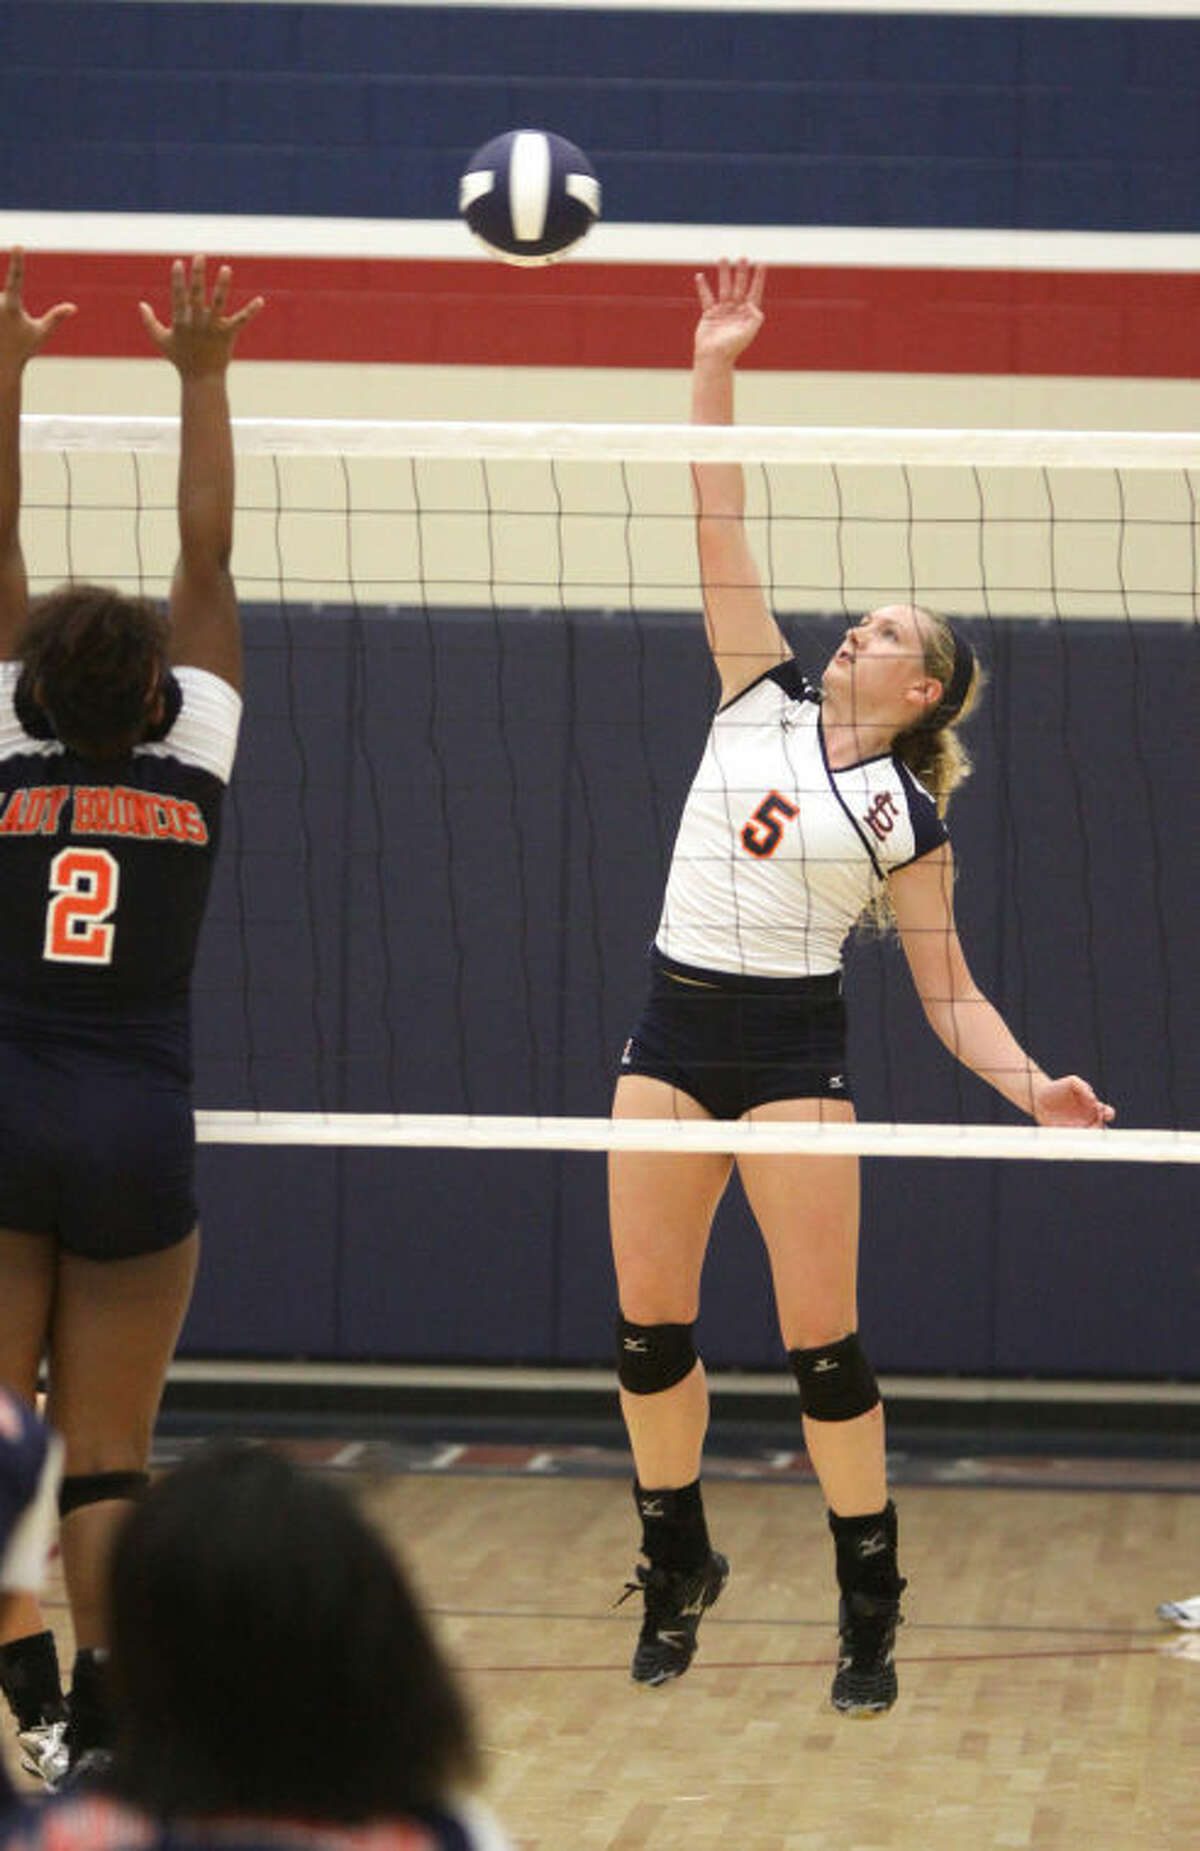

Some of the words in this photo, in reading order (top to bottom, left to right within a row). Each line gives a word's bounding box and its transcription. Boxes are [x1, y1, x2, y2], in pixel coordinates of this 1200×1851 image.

[0, 784, 70, 835] ADY
[71, 785, 208, 845] BRONCOS
[741, 789, 800, 859] 5
[43, 846, 119, 965] 2
